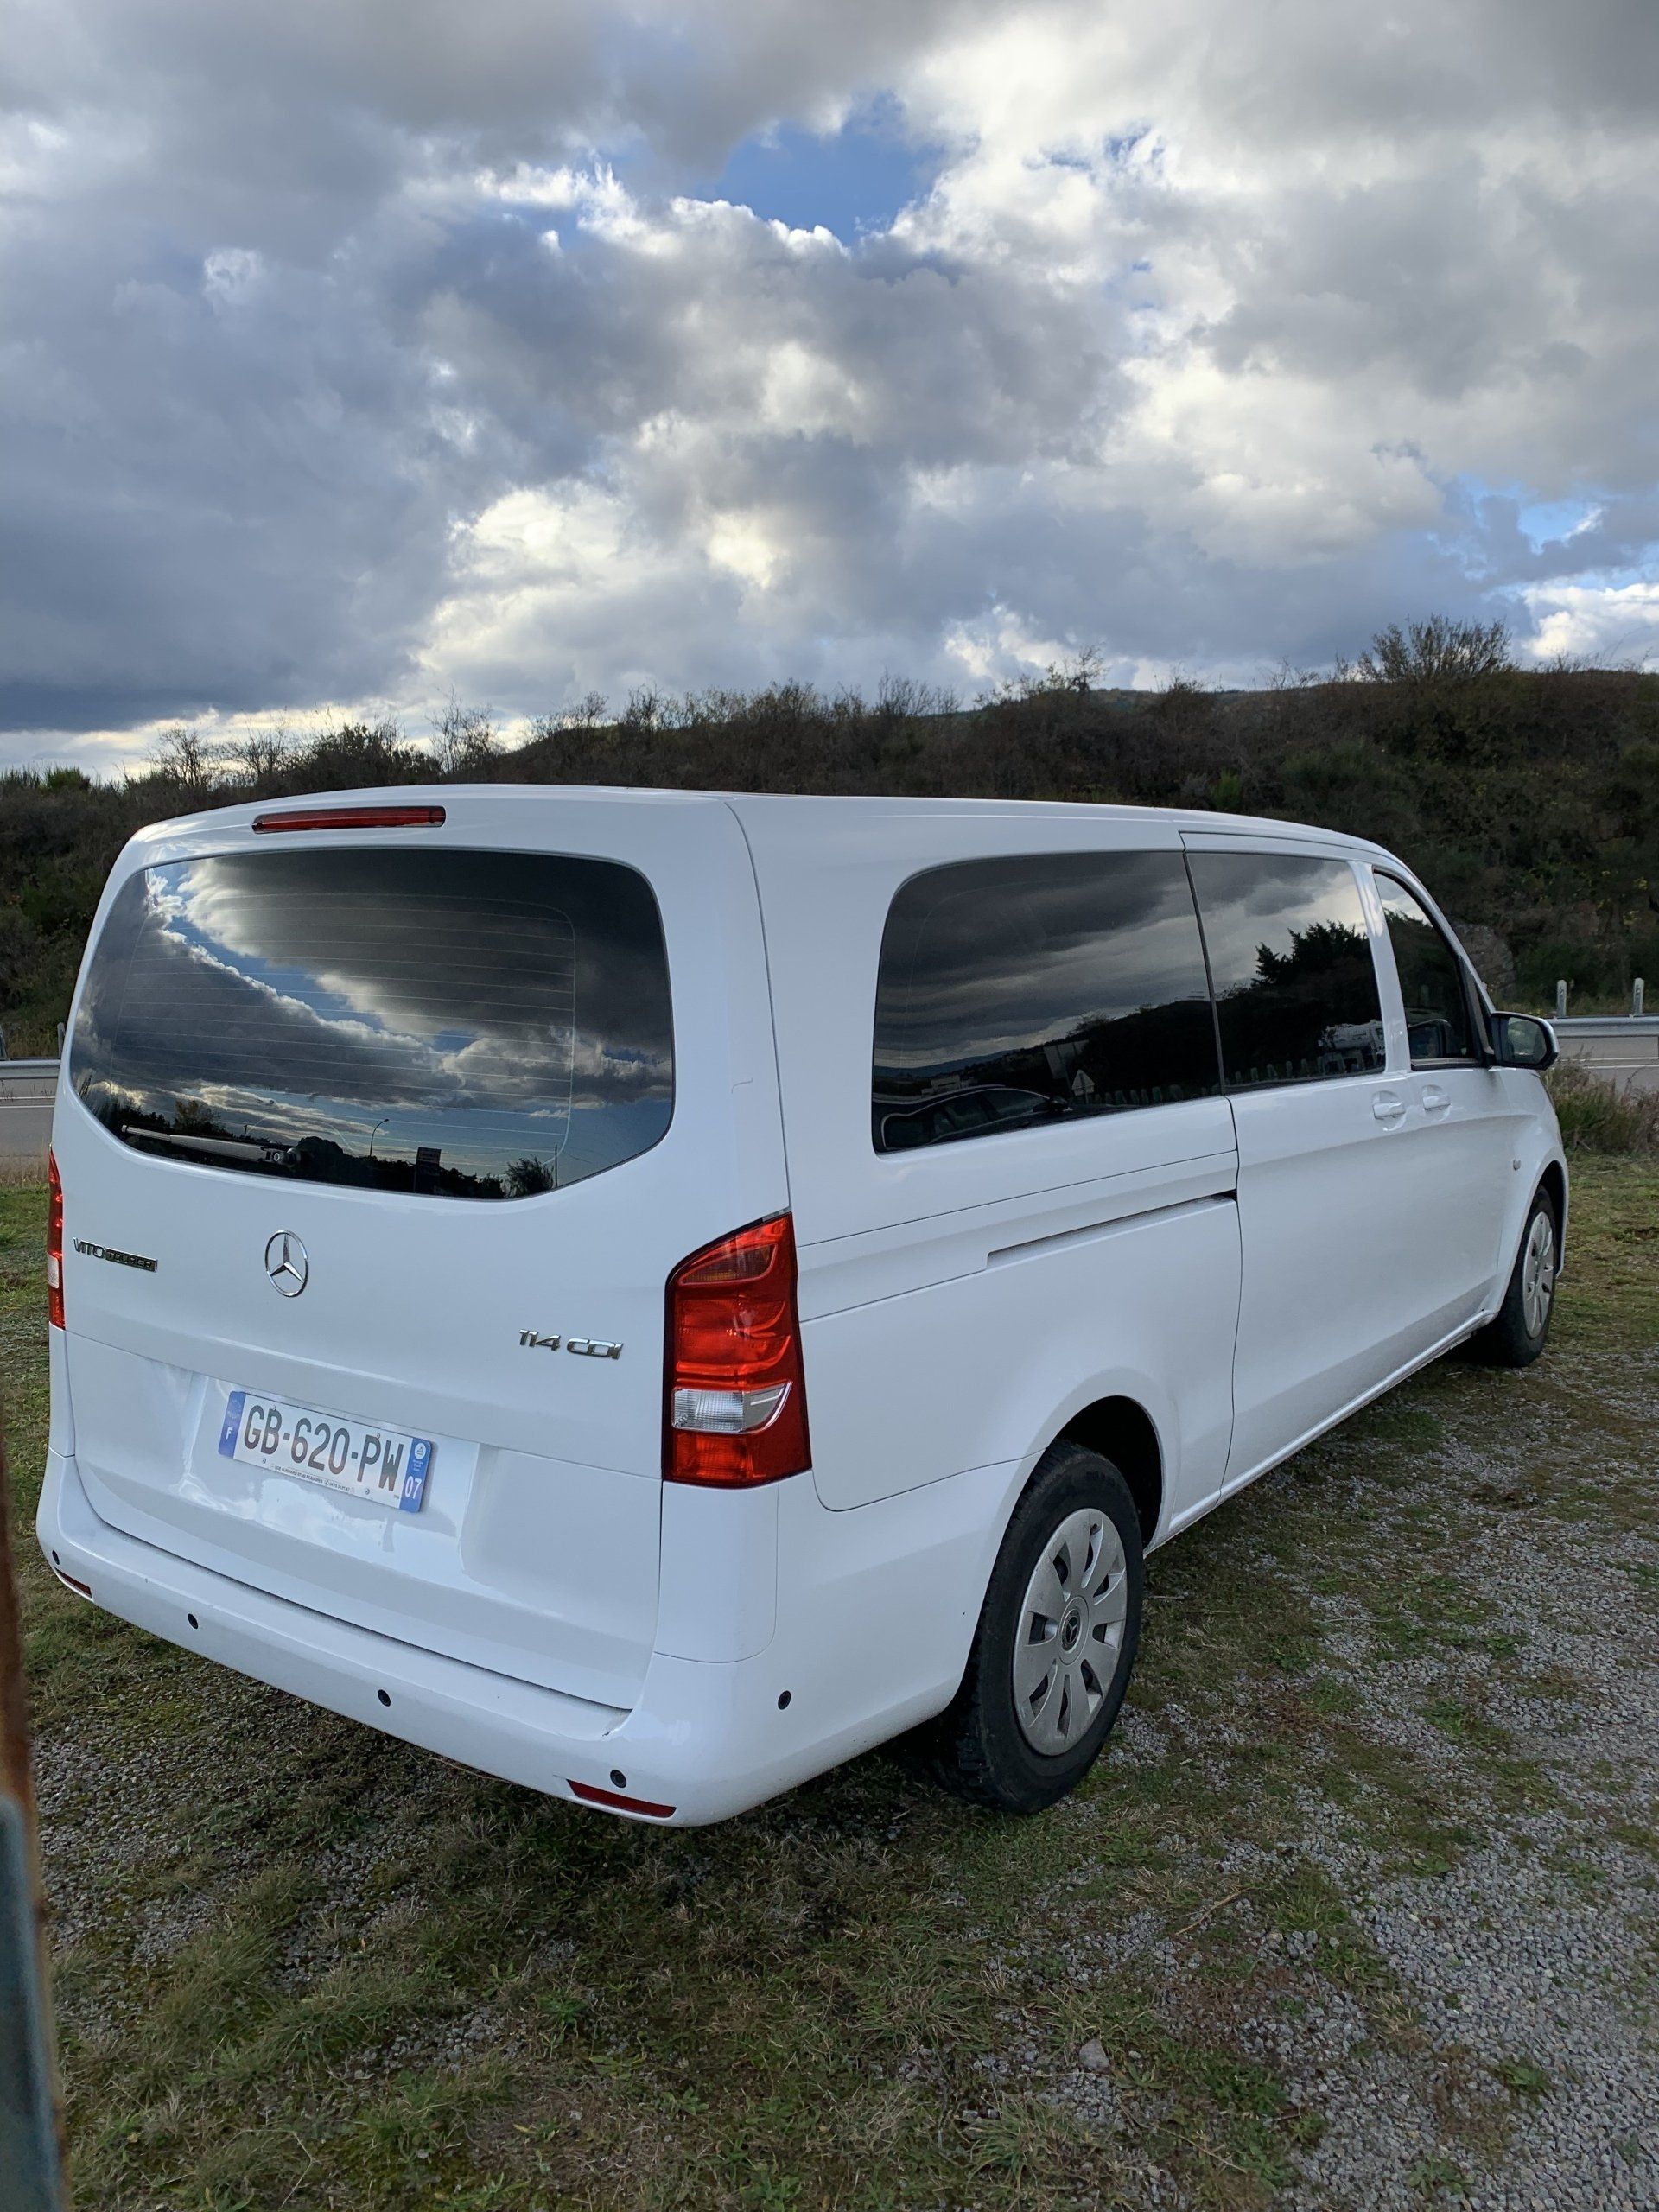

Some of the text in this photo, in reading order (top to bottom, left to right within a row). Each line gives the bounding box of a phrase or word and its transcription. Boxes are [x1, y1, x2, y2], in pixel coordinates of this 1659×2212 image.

[73, 1236, 105, 1260] VITO
[519, 1329, 623, 1360] 114 CDI
[226, 1427, 232, 1440] F
[244, 1405, 404, 1491] GB-620-PW
[404, 1475, 422, 1500] 07
